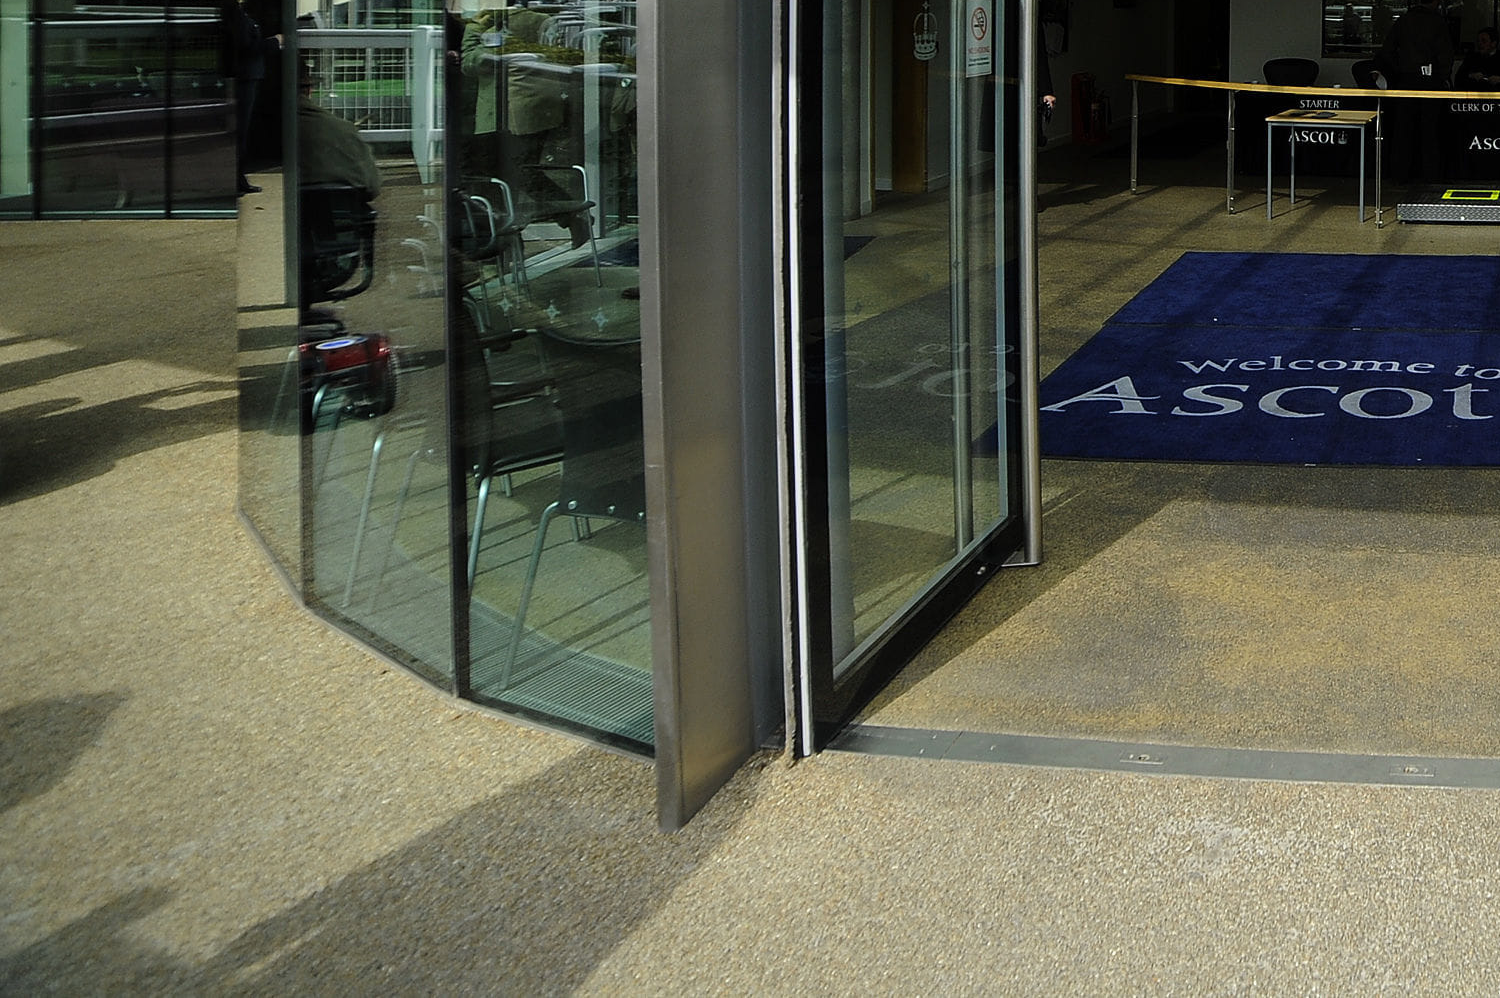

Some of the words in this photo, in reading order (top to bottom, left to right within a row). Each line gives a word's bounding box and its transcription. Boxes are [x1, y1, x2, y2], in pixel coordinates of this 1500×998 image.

[1299, 99, 1340, 109] STARTER
[1450, 103, 1480, 112] CLERK
[1482, 103, 1495, 112] OF
[1040, 375, 1493, 421] Ascot
